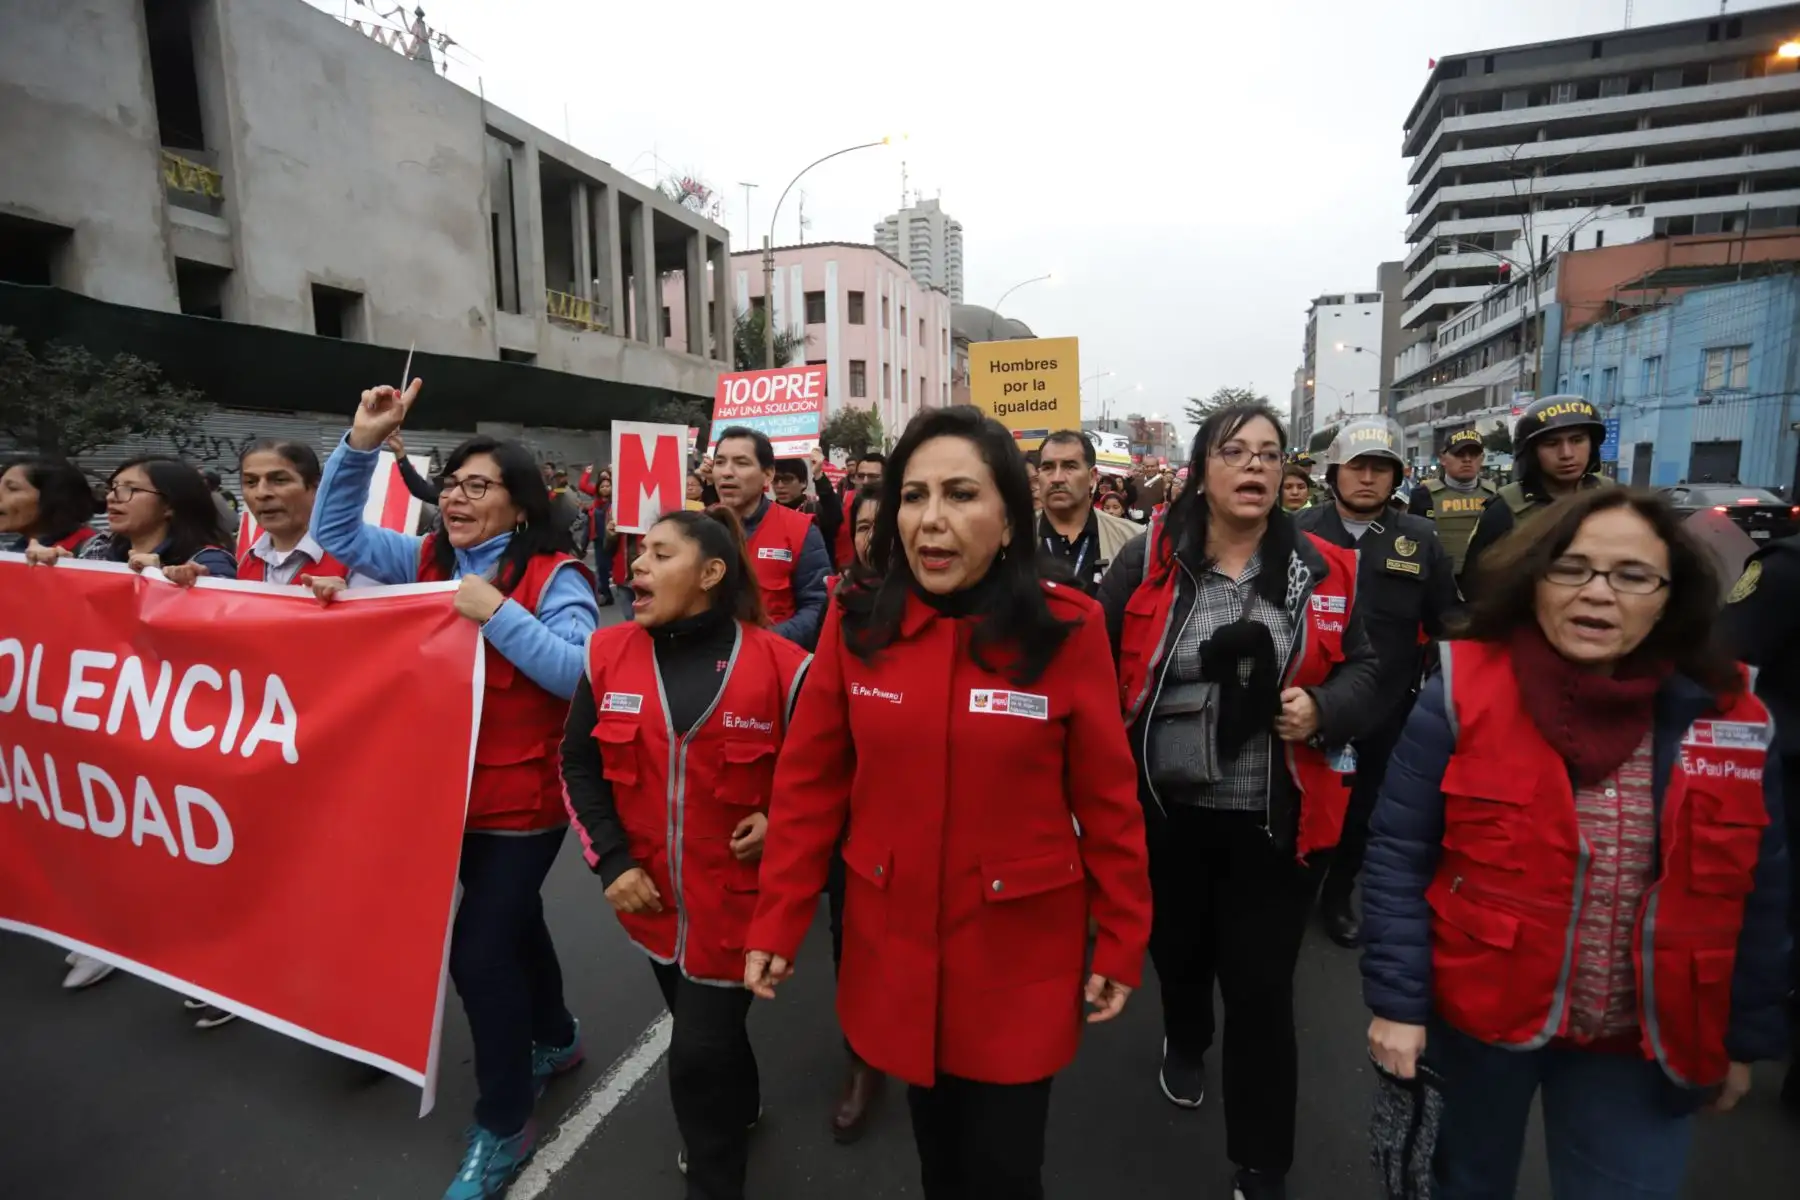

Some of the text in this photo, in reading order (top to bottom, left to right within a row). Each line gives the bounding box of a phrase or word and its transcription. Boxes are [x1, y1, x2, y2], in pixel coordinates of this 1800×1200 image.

[990, 358, 1058, 373] Hombres
[723, 372, 821, 405] 100PRE
[1003, 379, 1045, 396] por la
[718, 407, 738, 417] HAY
[740, 406, 762, 416] UNA
[993, 398, 1057, 416] igualdad
[617, 433, 683, 527] M
